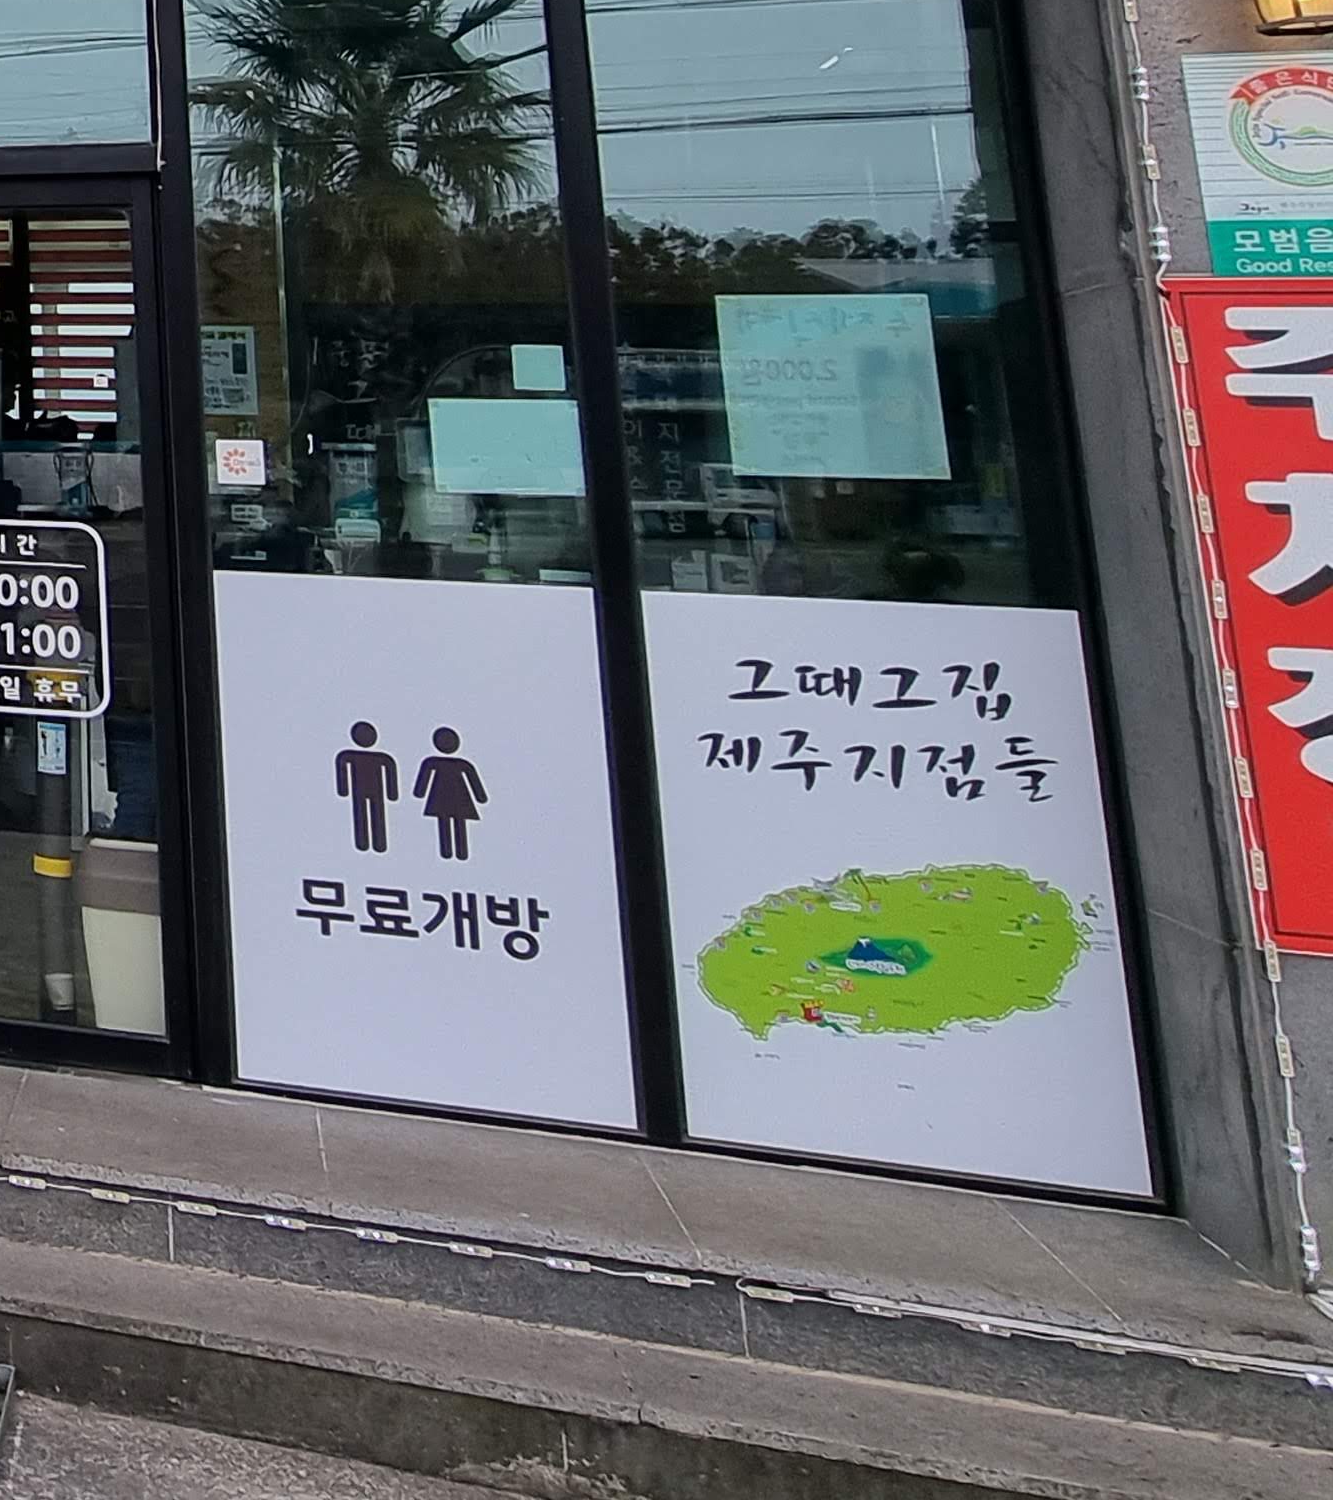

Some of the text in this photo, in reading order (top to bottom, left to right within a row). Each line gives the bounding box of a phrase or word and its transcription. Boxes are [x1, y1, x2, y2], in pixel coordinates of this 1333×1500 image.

[1233, 227, 1333, 253] 모범음
[1236, 258, 1292, 273] Good
[32, 676, 82, 703] 휴무
[726, 658, 1013, 723] 그때그집
[696, 727, 1060, 803] 제주지점들
[294, 877, 550, 962] 무료개방
